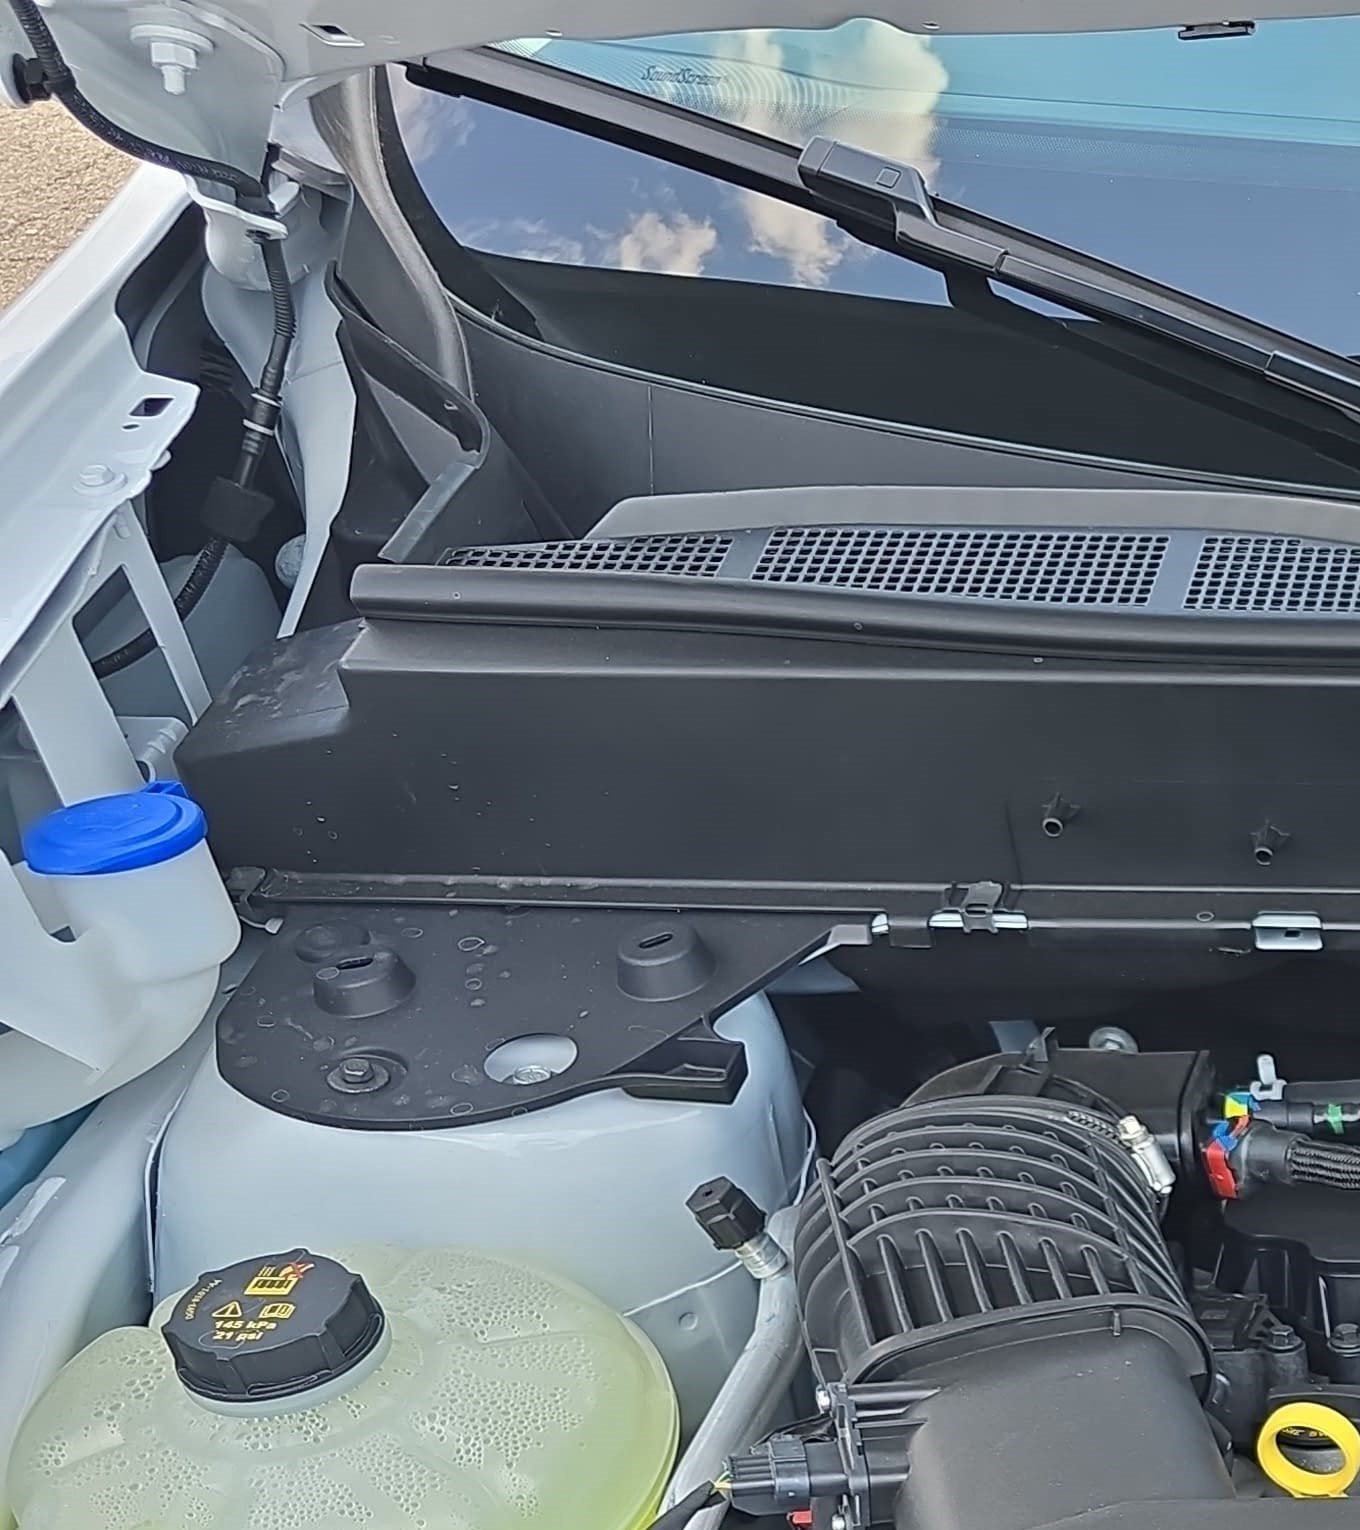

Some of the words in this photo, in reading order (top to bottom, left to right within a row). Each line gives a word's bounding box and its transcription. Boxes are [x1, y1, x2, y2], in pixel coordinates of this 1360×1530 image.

[213, 1320, 243, 1330] 145
[243, 1320, 278, 1330] kPa
[212, 1331, 235, 1341] 21
[236, 1331, 264, 1342] psi
